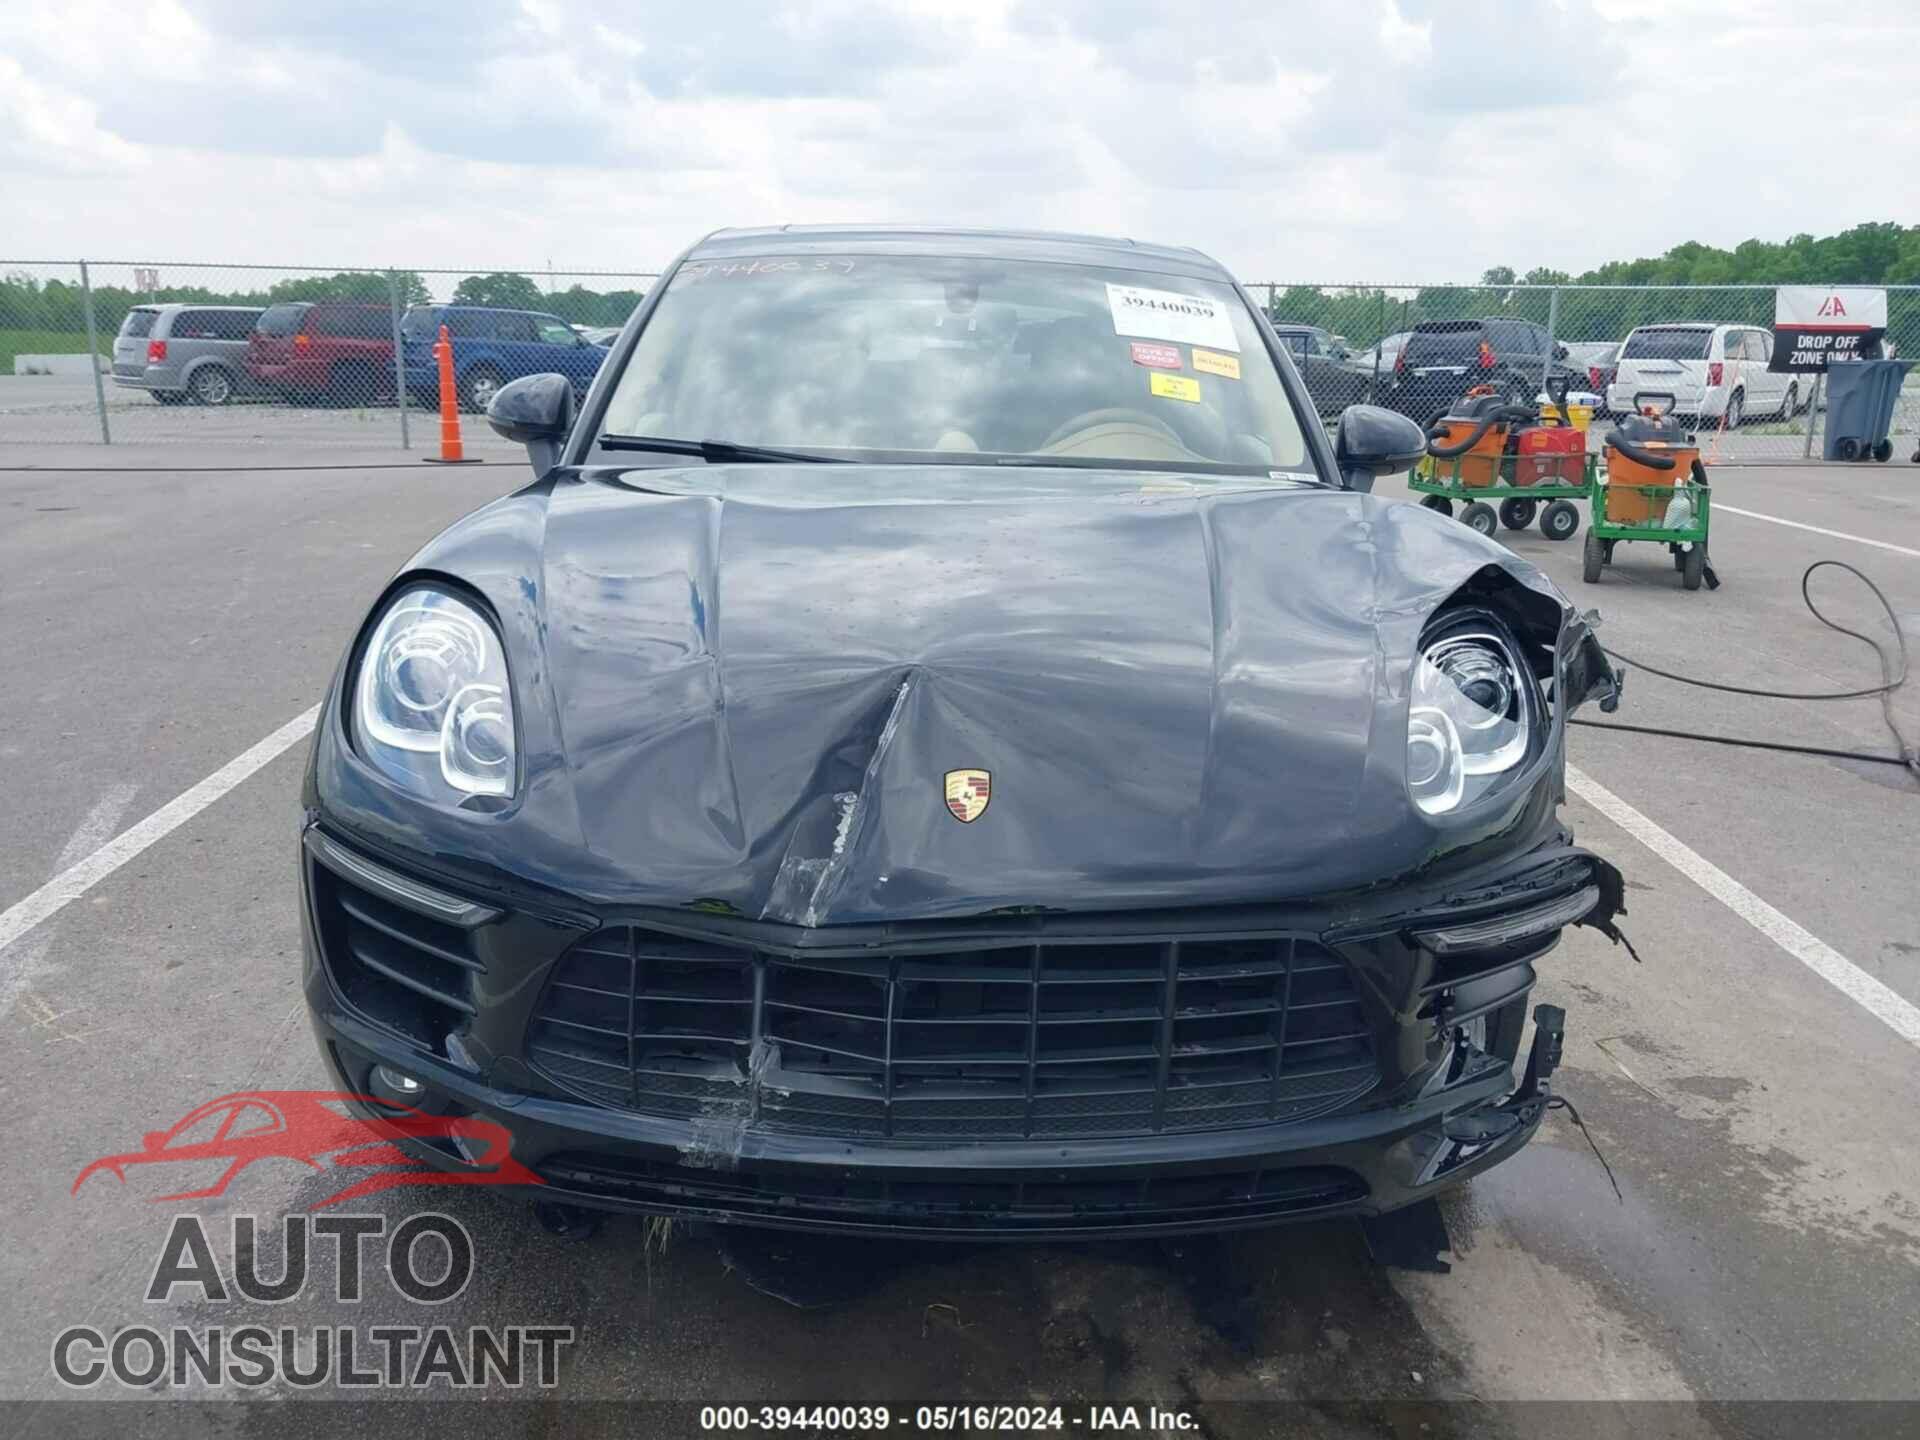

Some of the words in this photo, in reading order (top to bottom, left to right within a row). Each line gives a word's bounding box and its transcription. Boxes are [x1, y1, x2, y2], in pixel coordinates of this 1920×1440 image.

[1121, 296, 1215, 318] 39440039
[1797, 335, 1832, 349] DROP
[1835, 336, 1860, 349] OFF
[1789, 351, 1824, 365] ZONE
